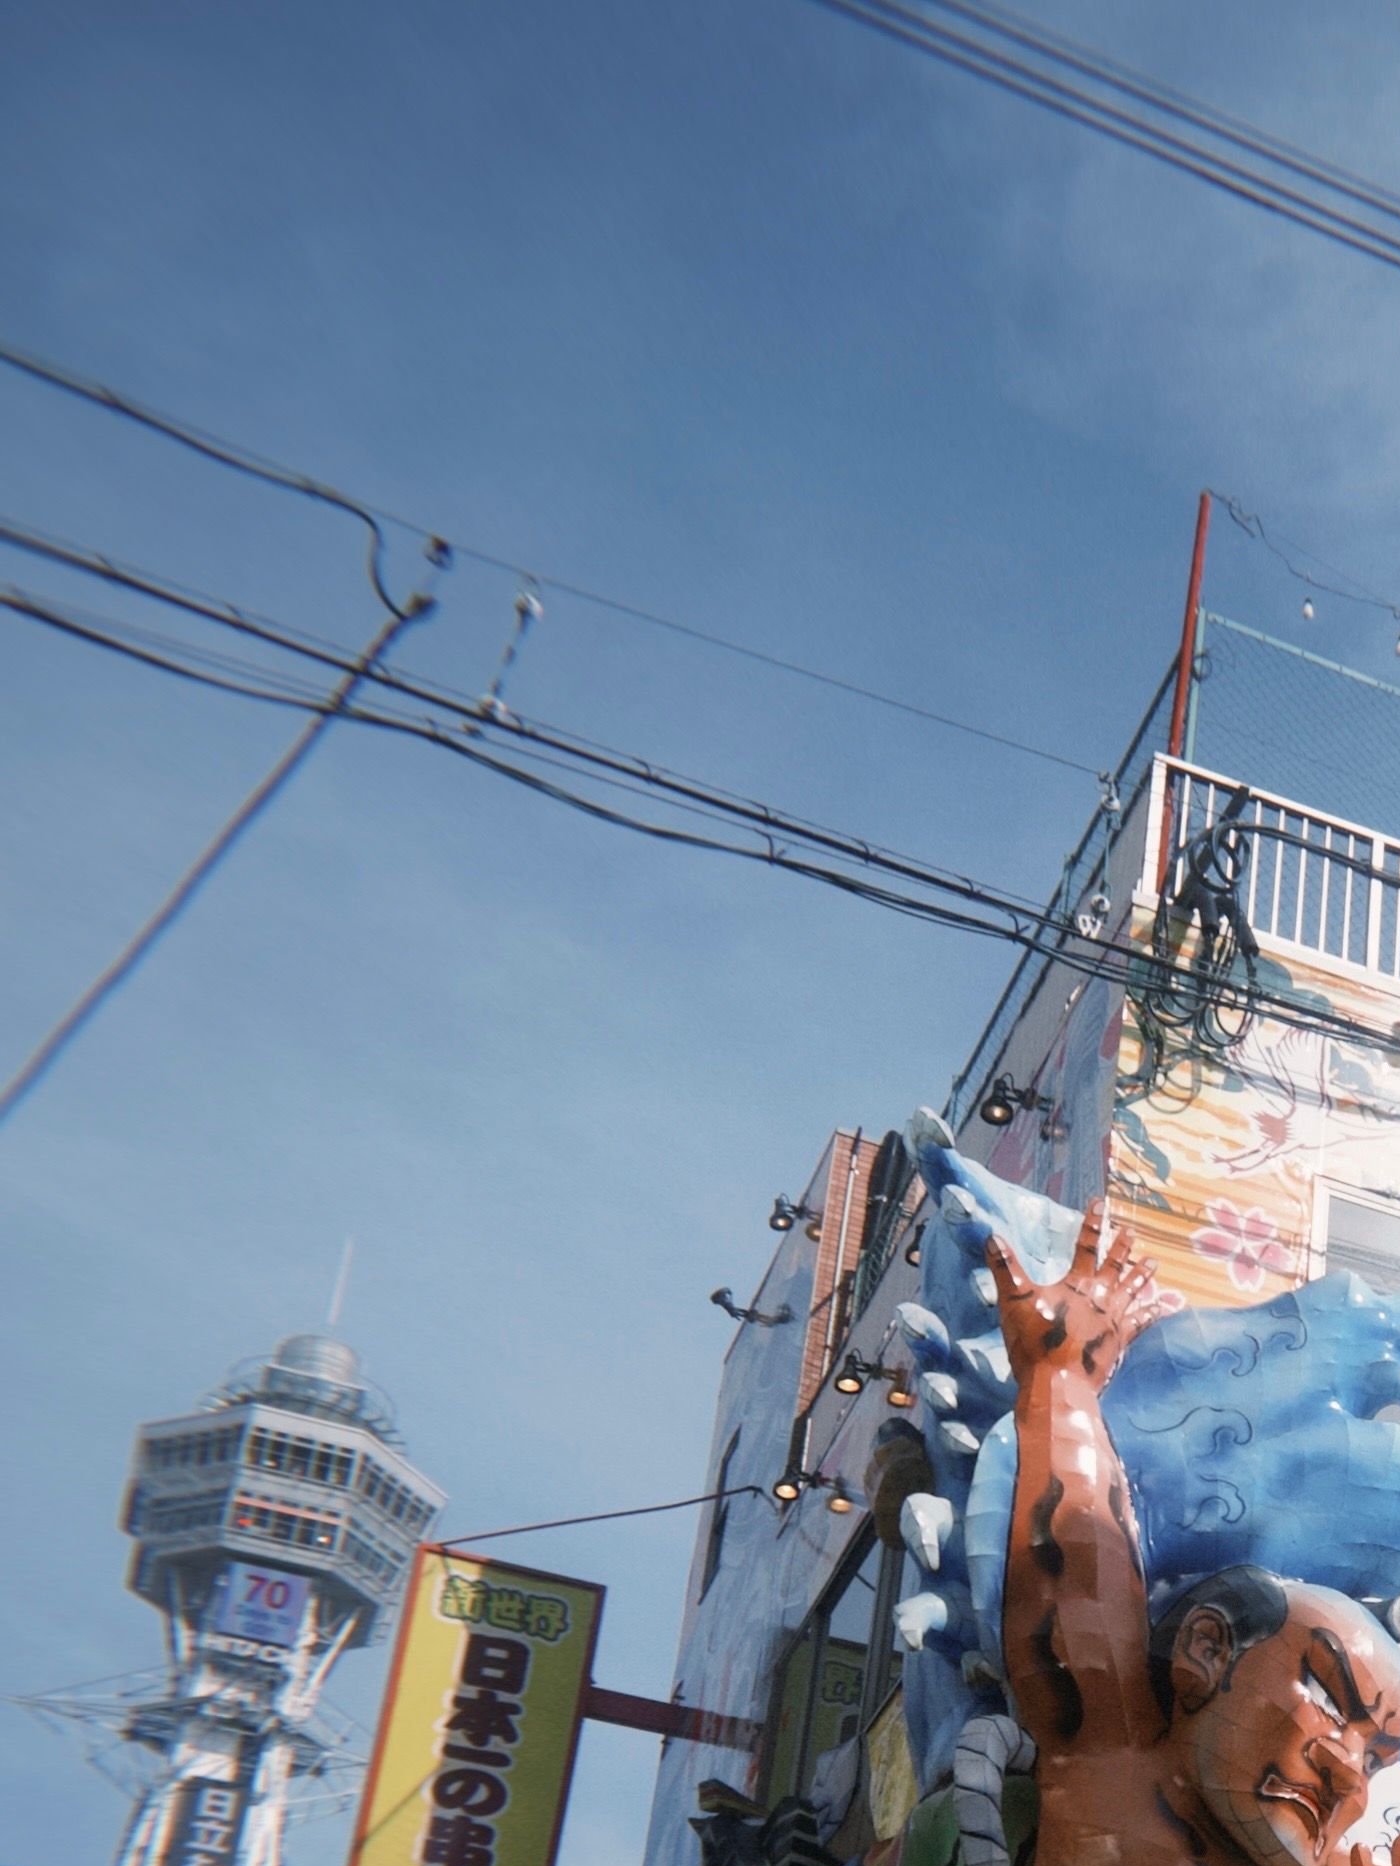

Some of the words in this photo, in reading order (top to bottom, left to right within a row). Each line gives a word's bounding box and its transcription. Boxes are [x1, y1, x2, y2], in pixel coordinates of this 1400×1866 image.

[245, 1574, 290, 1609] 70
[441, 1574, 568, 1641] 新世界
